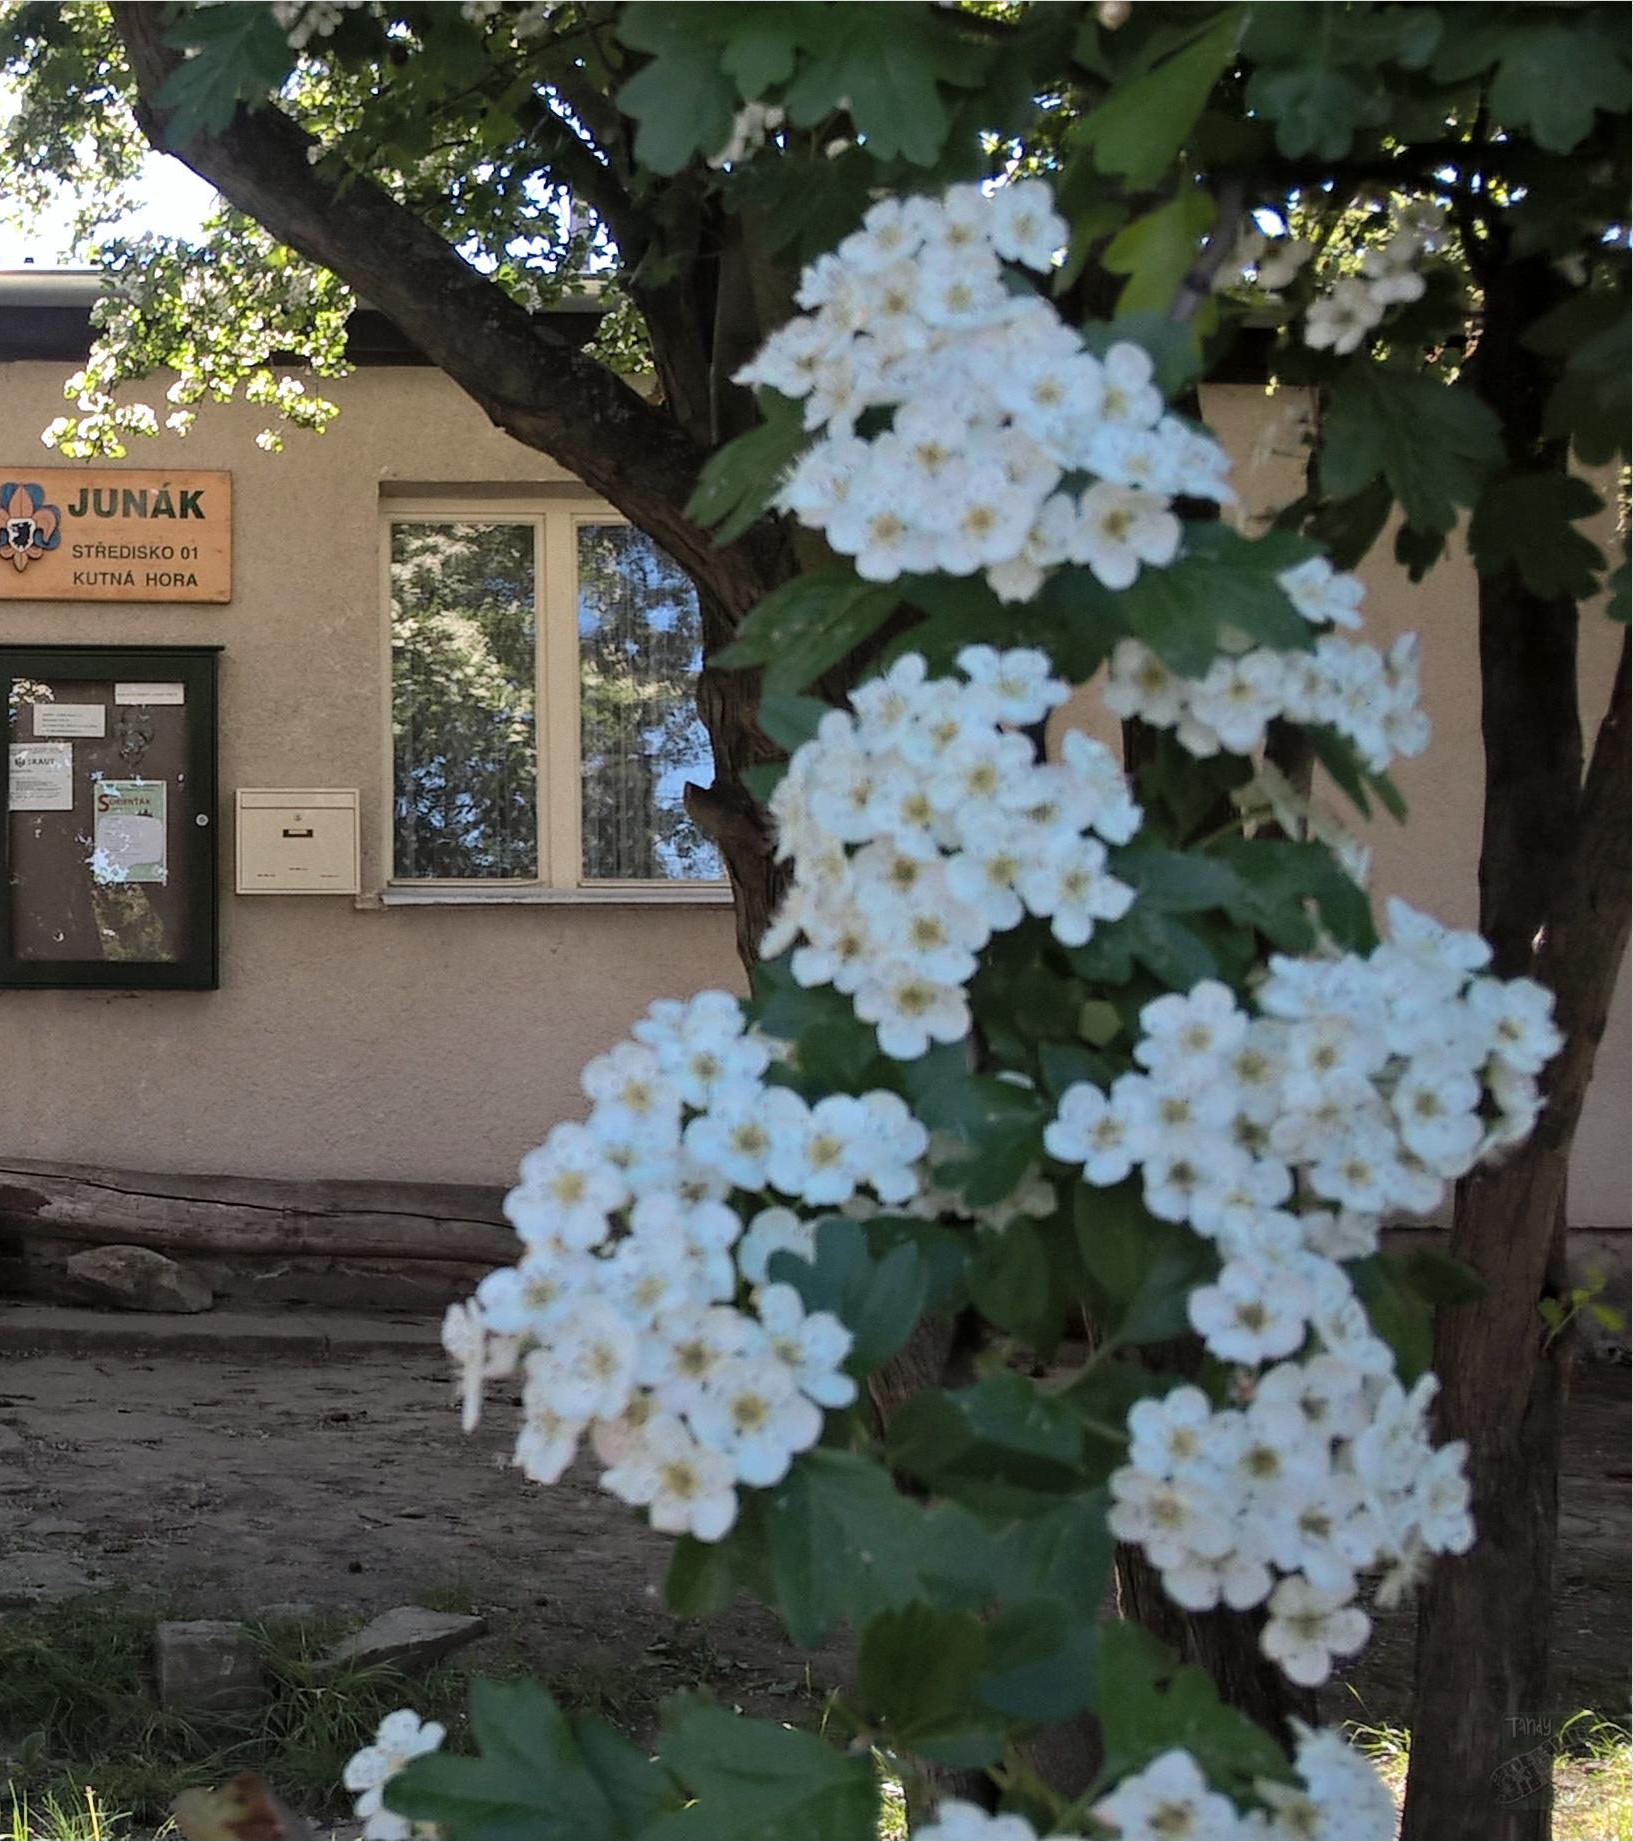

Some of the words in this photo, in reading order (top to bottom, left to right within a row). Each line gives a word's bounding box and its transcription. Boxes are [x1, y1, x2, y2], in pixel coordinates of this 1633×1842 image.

[68, 482, 205, 519] JUNÁK
[72, 541, 175, 560] STŘEDISKO
[180, 546, 199, 560] 01
[73, 569, 135, 585] KUTNÁ
[146, 573, 198, 587] HORA
